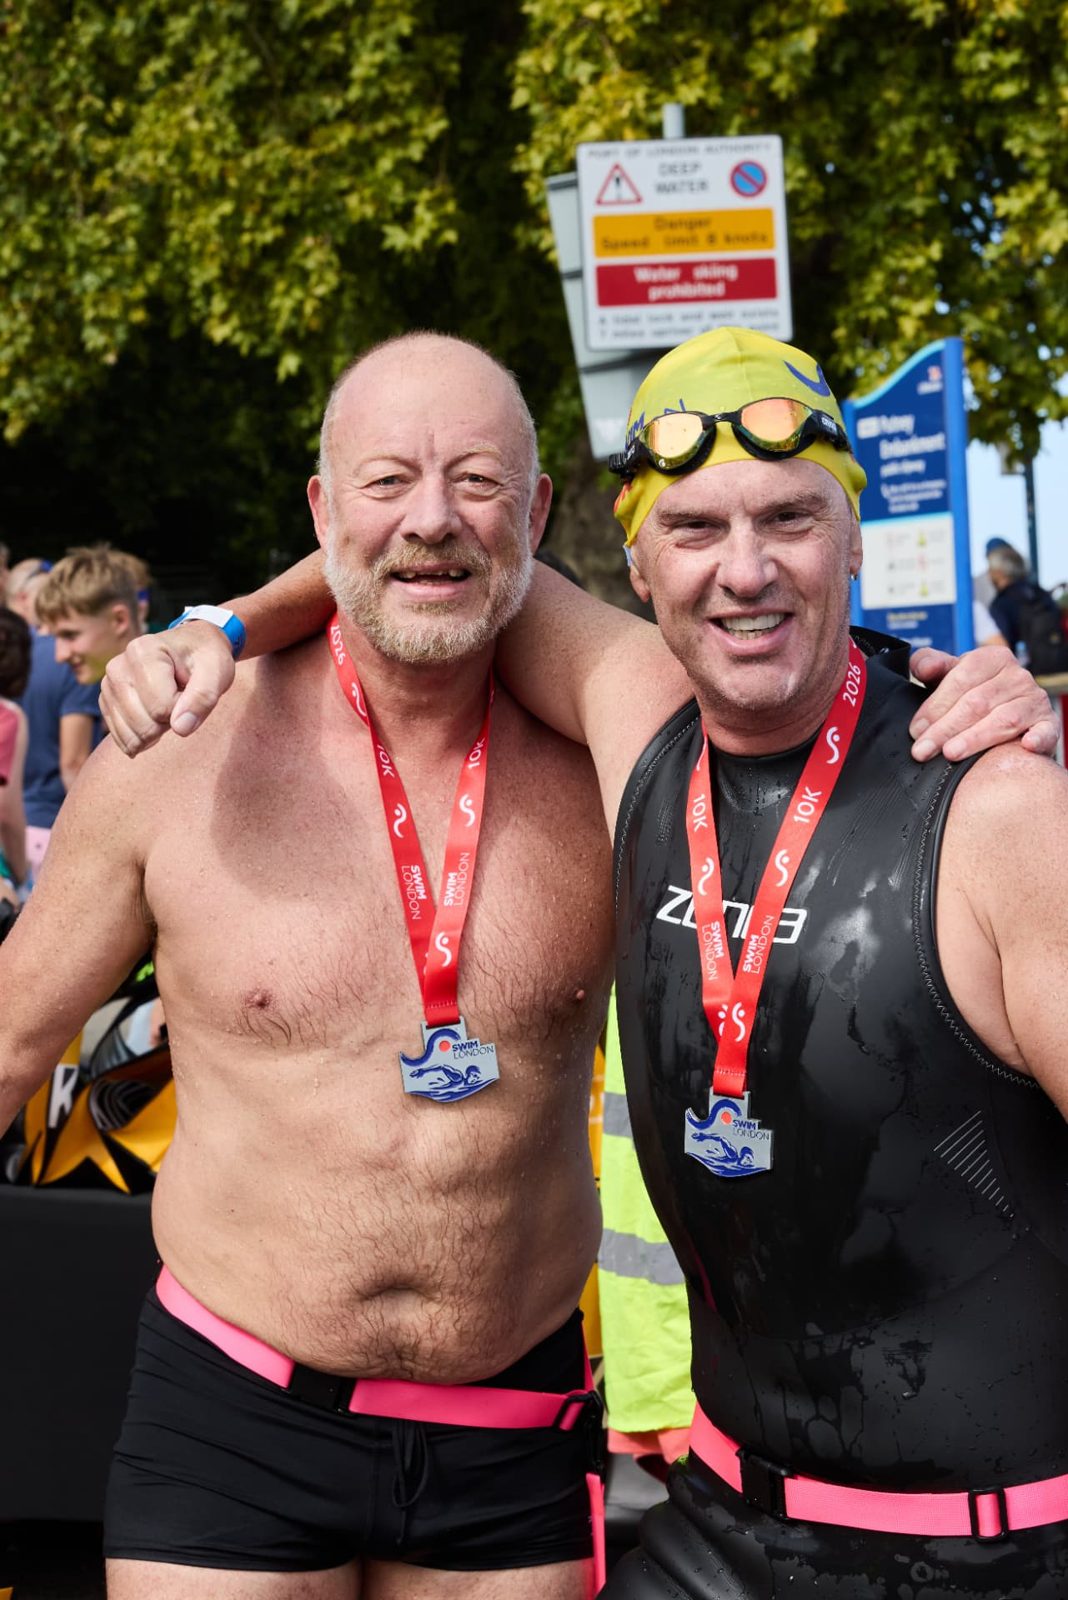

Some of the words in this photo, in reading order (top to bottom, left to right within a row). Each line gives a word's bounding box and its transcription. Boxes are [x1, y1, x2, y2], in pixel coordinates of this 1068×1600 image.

[659, 162, 702, 176] DEEP
[655, 180, 709, 195] WATER
[634, 266, 681, 283] Water
[648, 281, 726, 302] prohibited
[842, 661, 863, 707] 2026
[377, 743, 396, 778] 10K
[468, 737, 486, 770] 10K
[692, 793, 709, 832] 10K
[793, 786, 823, 824] 10K
[401, 865, 422, 920] LONDON
[410, 864, 427, 900] SWIM
[443, 871, 458, 907] SWIM
[454, 852, 471, 907] LONDON
[702, 924, 718, 981] LONDON
[711, 920, 725, 959] SWIM
[742, 934, 760, 973] SWIM
[751, 914, 776, 975] LONDON
[452, 1040, 479, 1052] SWIM
[453, 1045, 495, 1060] LONDON
[732, 1119, 757, 1131] SWIM
[732, 1128, 770, 1141] LONDON
